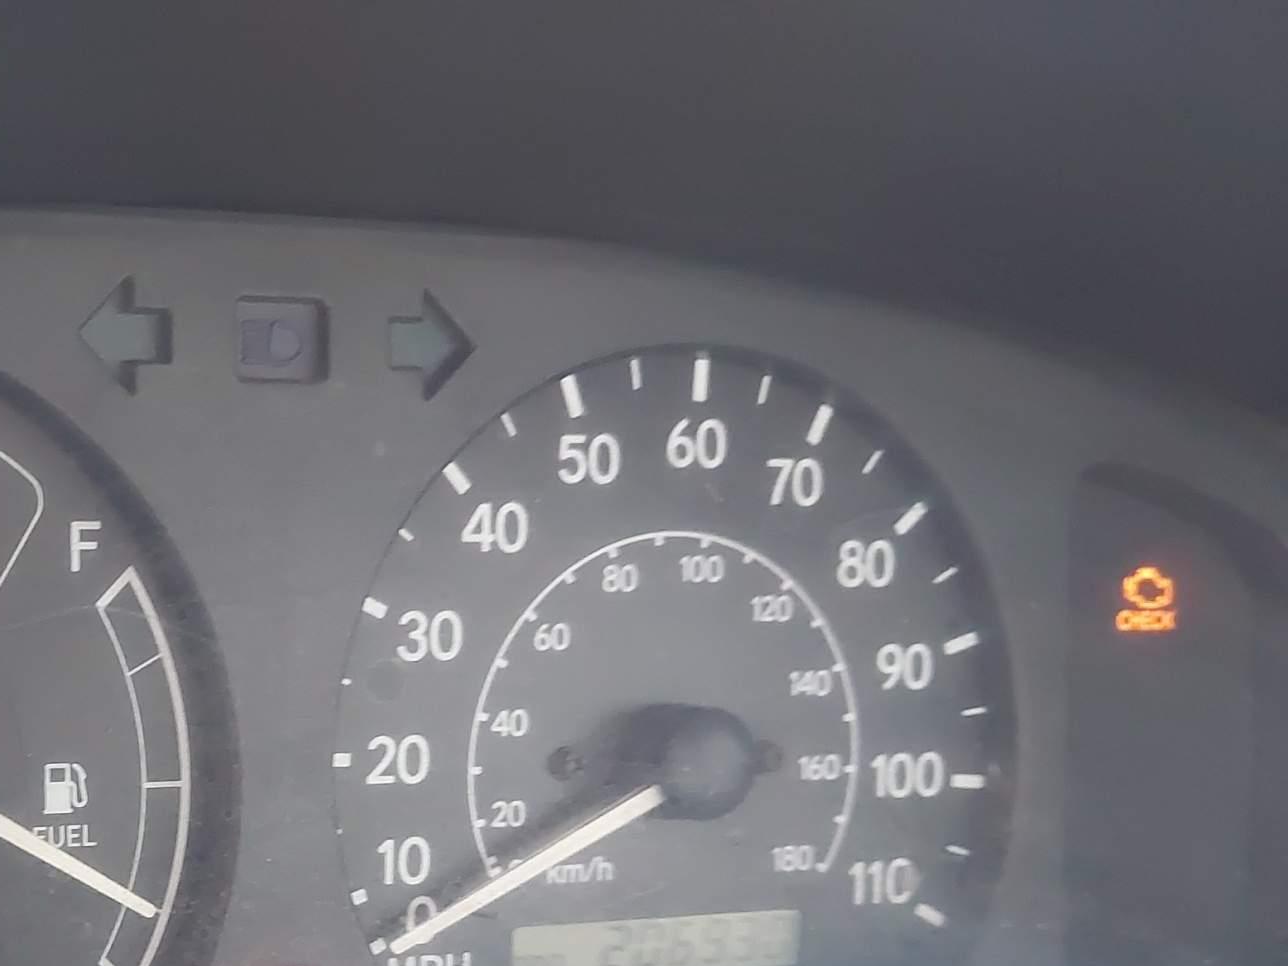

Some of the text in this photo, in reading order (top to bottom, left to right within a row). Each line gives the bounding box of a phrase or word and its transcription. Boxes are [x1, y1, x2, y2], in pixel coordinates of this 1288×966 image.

[558, 433, 620, 485] 50
[666, 418, 727, 469] 60
[766, 458, 823, 507] 70
[70, 520, 101, 572] F
[461, 501, 529, 554] 40
[602, 564, 638, 593] 80
[679, 555, 724, 583] 100
[837, 539, 895, 588] 80
[751, 595, 792, 623] 120
[396, 610, 463, 662] 30
[533, 622, 570, 651] 60
[789, 668, 834, 697] 140
[876, 643, 932, 690] 90
[490, 708, 529, 737] 40
[365, 734, 430, 785] 20
[798, 754, 845, 781] 160
[871, 751, 943, 799] 100
[32, 825, 98, 848] FUEL
[490, 800, 526, 828] 20
[377, 836, 431, 886] 10
[546, 855, 615, 884] km/h
[772, 845, 813, 872] 180
[848, 858, 914, 905] 110
